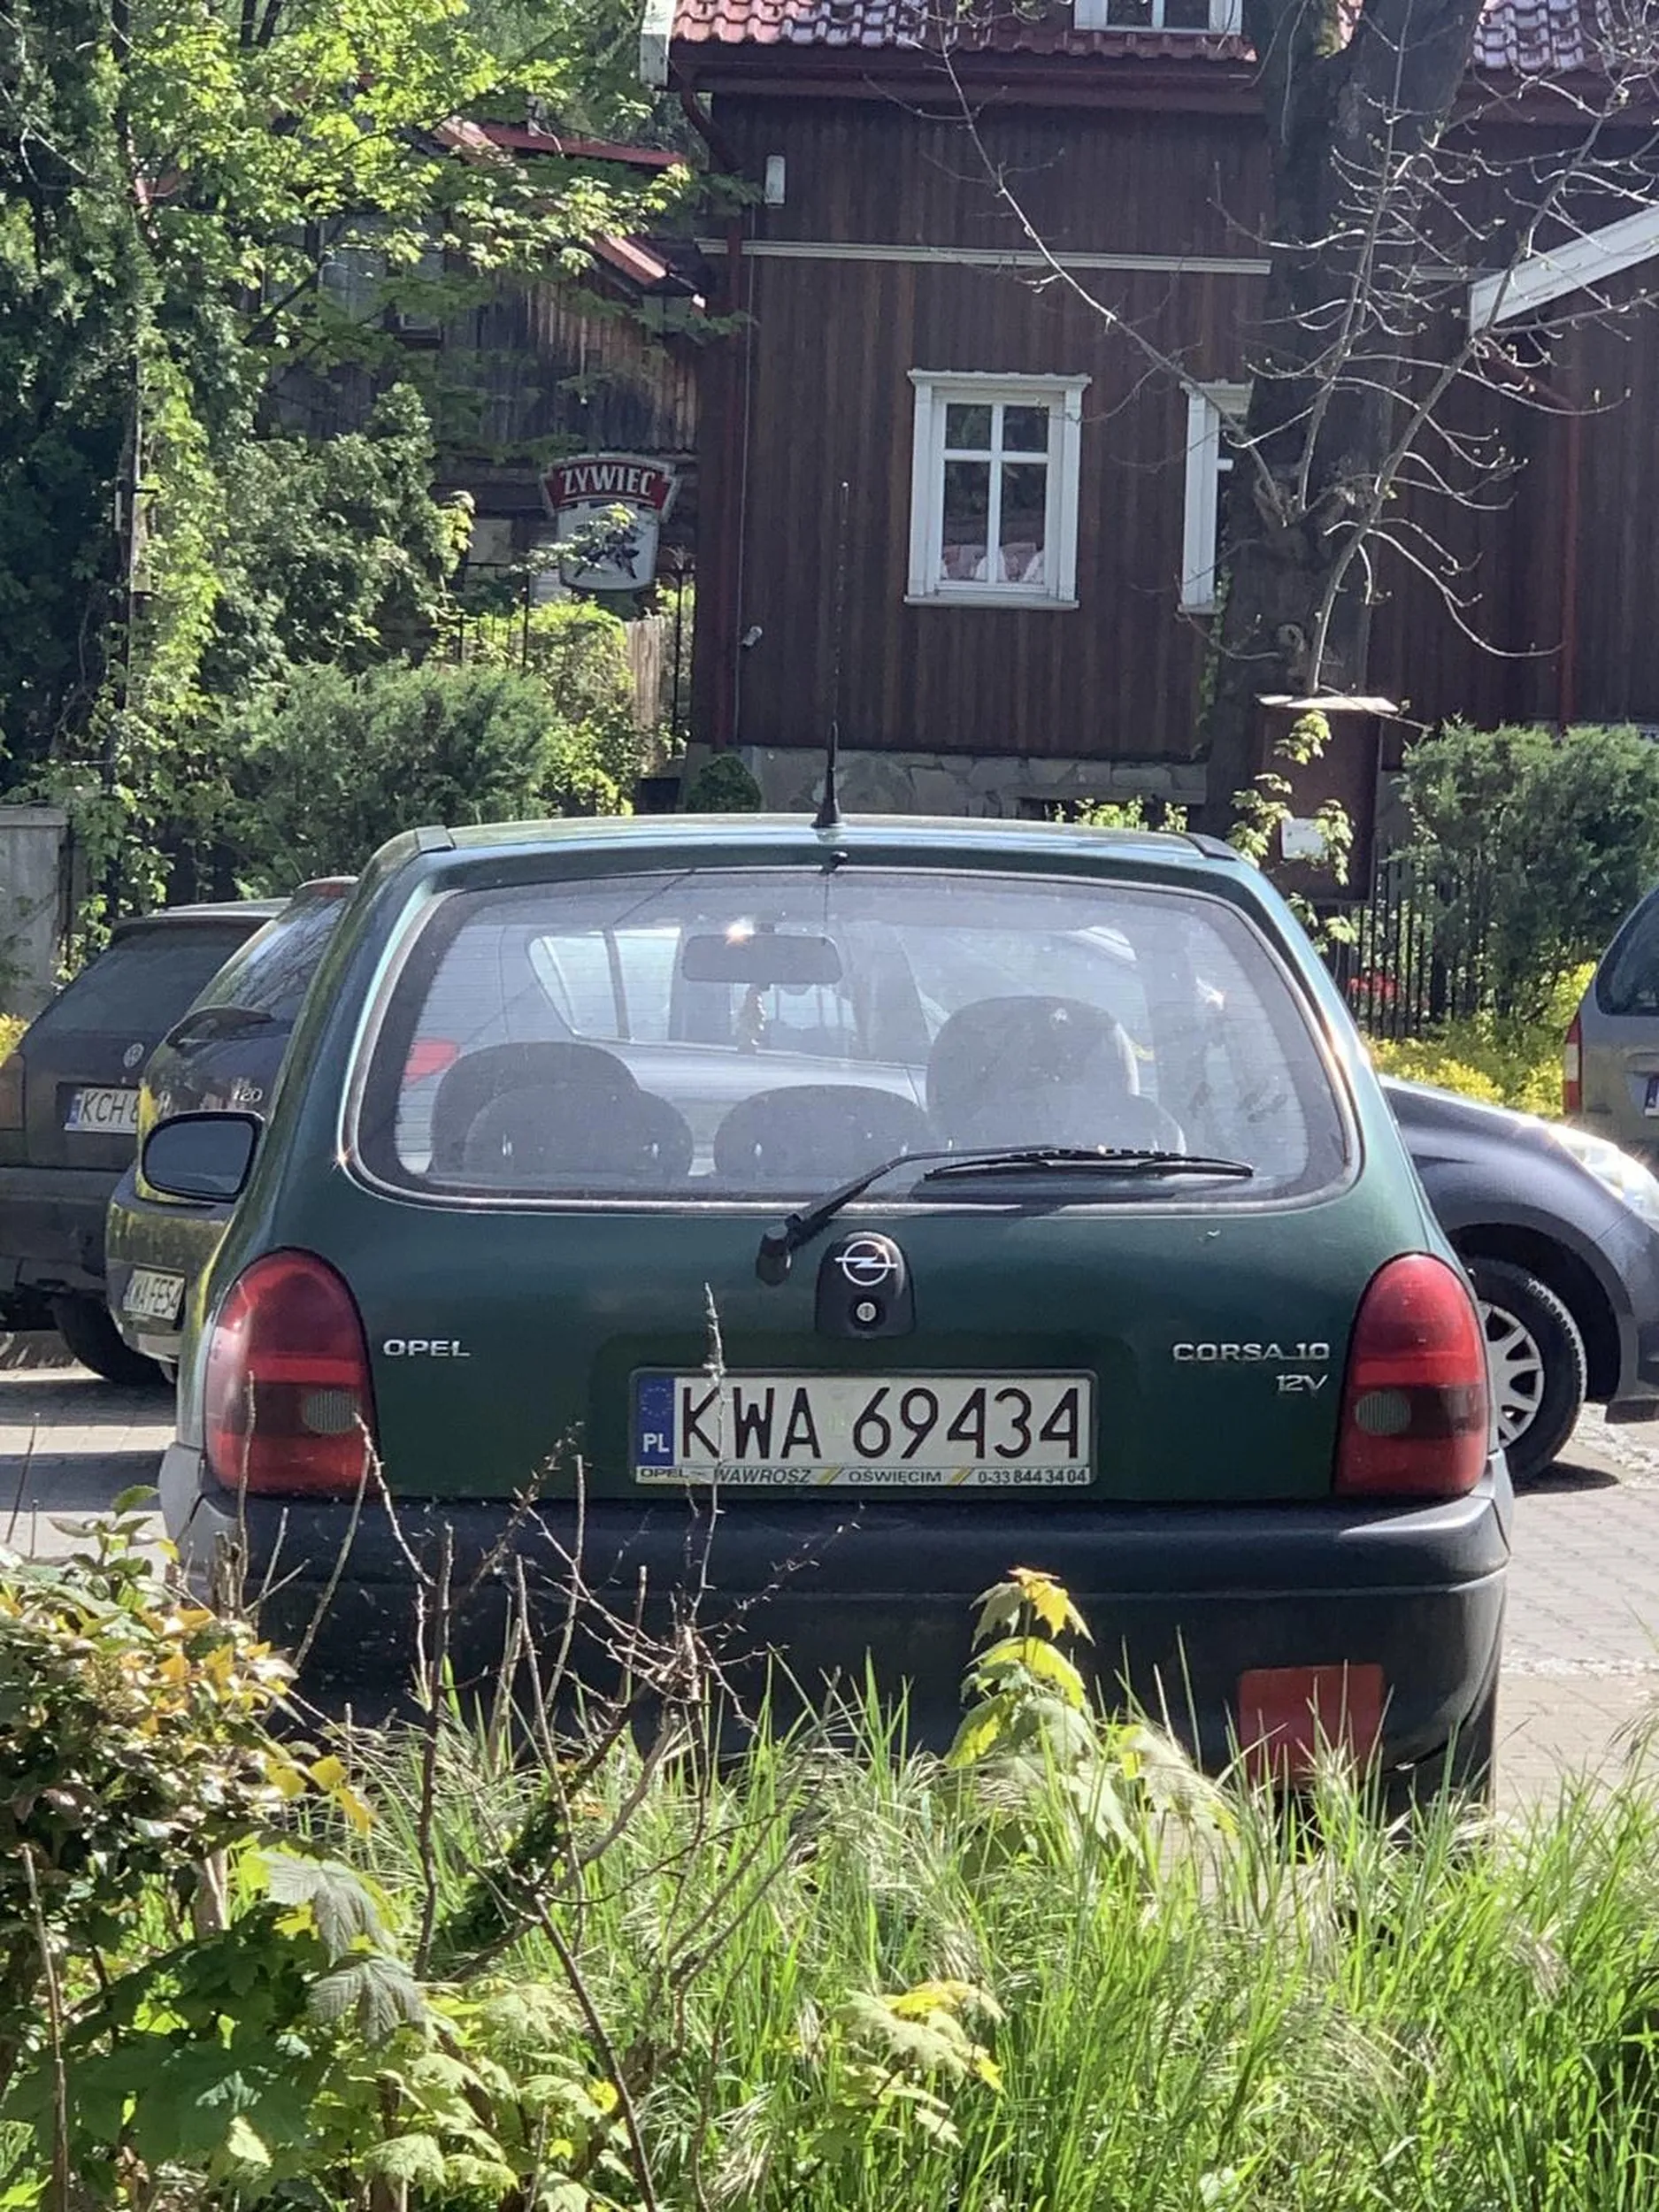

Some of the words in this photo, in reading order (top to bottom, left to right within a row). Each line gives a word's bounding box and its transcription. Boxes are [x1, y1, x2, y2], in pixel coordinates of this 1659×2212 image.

[81, 1092, 128, 1124] KCH
[383, 1339, 471, 1357] OPEL
[1172, 1342, 1285, 1361] CORSA
[1276, 1374, 1328, 1393] 12V
[682, 1386, 822, 1459] KWA
[852, 1386, 1079, 1460] 69434
[642, 1433, 670, 1453] PL
[713, 1468, 811, 1484] WAWROSZ
